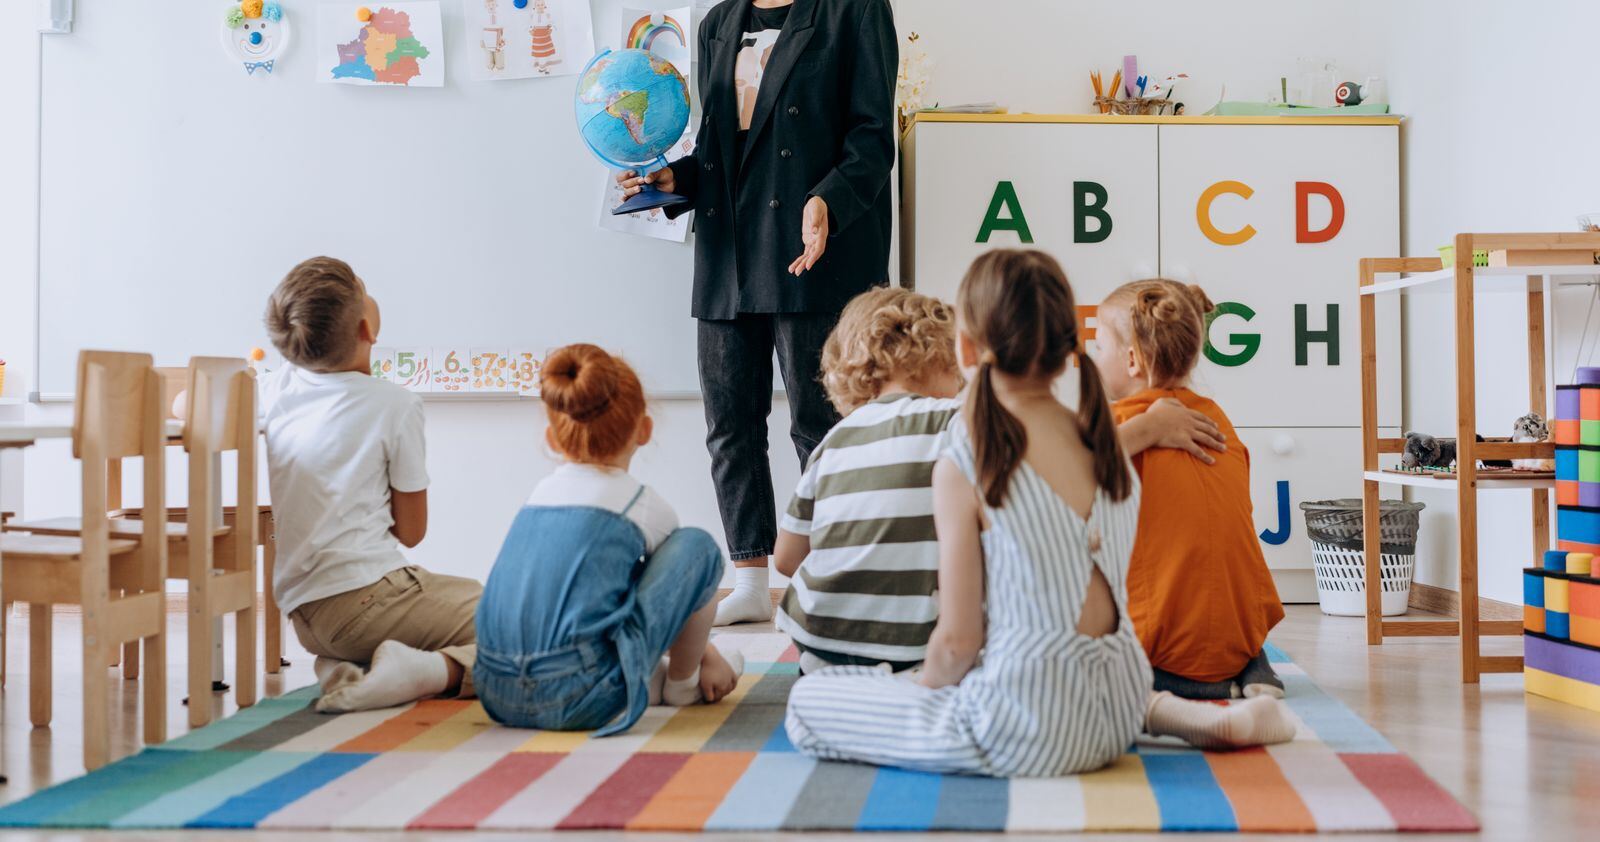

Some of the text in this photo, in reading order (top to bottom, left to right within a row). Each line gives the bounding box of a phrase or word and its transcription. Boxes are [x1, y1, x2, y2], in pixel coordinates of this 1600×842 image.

[975, 180, 1345, 246] A B C D
[397, 352, 416, 378] 5
[444, 350, 460, 374] 6
[481, 352, 499, 375] 7
[520, 360, 535, 382] 8
[1203, 301, 1262, 367] G
[1294, 303, 1340, 365] H
[1259, 480, 1292, 545] J
